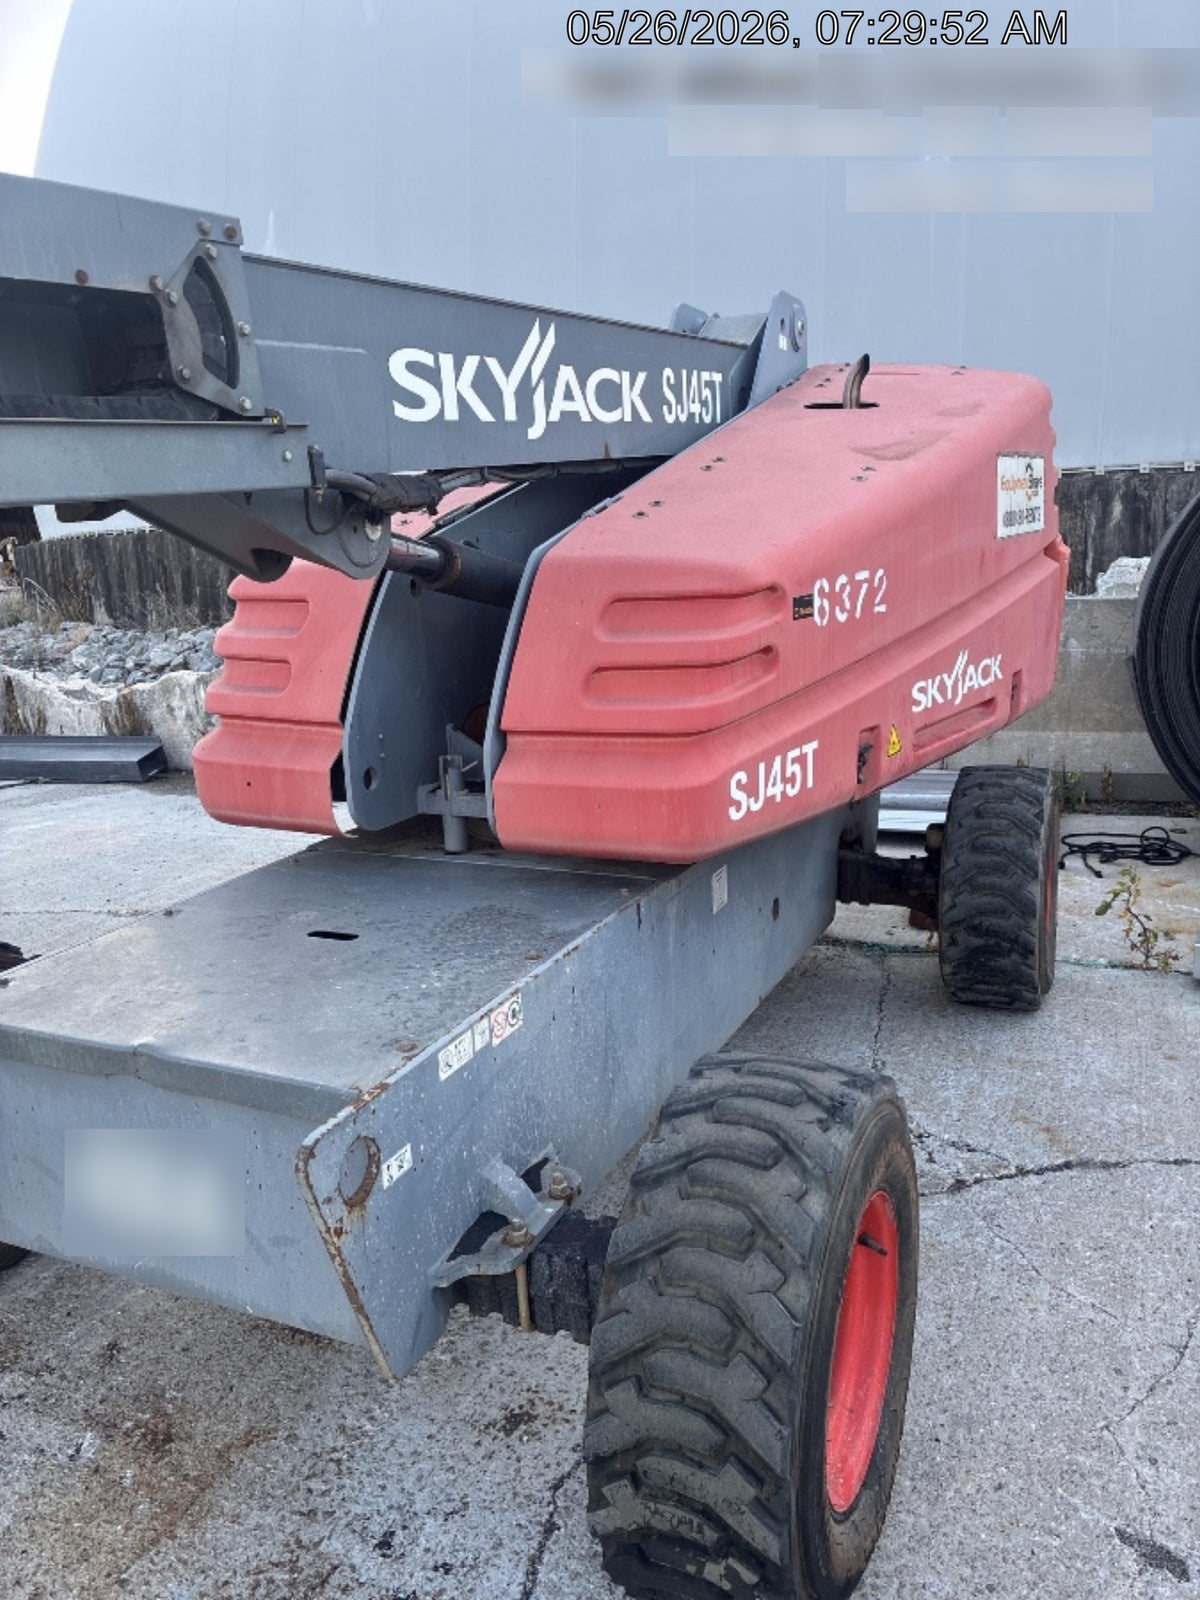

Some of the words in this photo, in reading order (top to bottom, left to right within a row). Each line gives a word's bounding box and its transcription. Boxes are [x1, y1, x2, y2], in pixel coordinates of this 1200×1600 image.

[388, 318, 653, 440] SKYJACK
[662, 367, 723, 424] SJ45T
[813, 568, 887, 626] 6372
[911, 647, 1003, 712] SKYJACK
[728, 740, 819, 822] SJ45T
